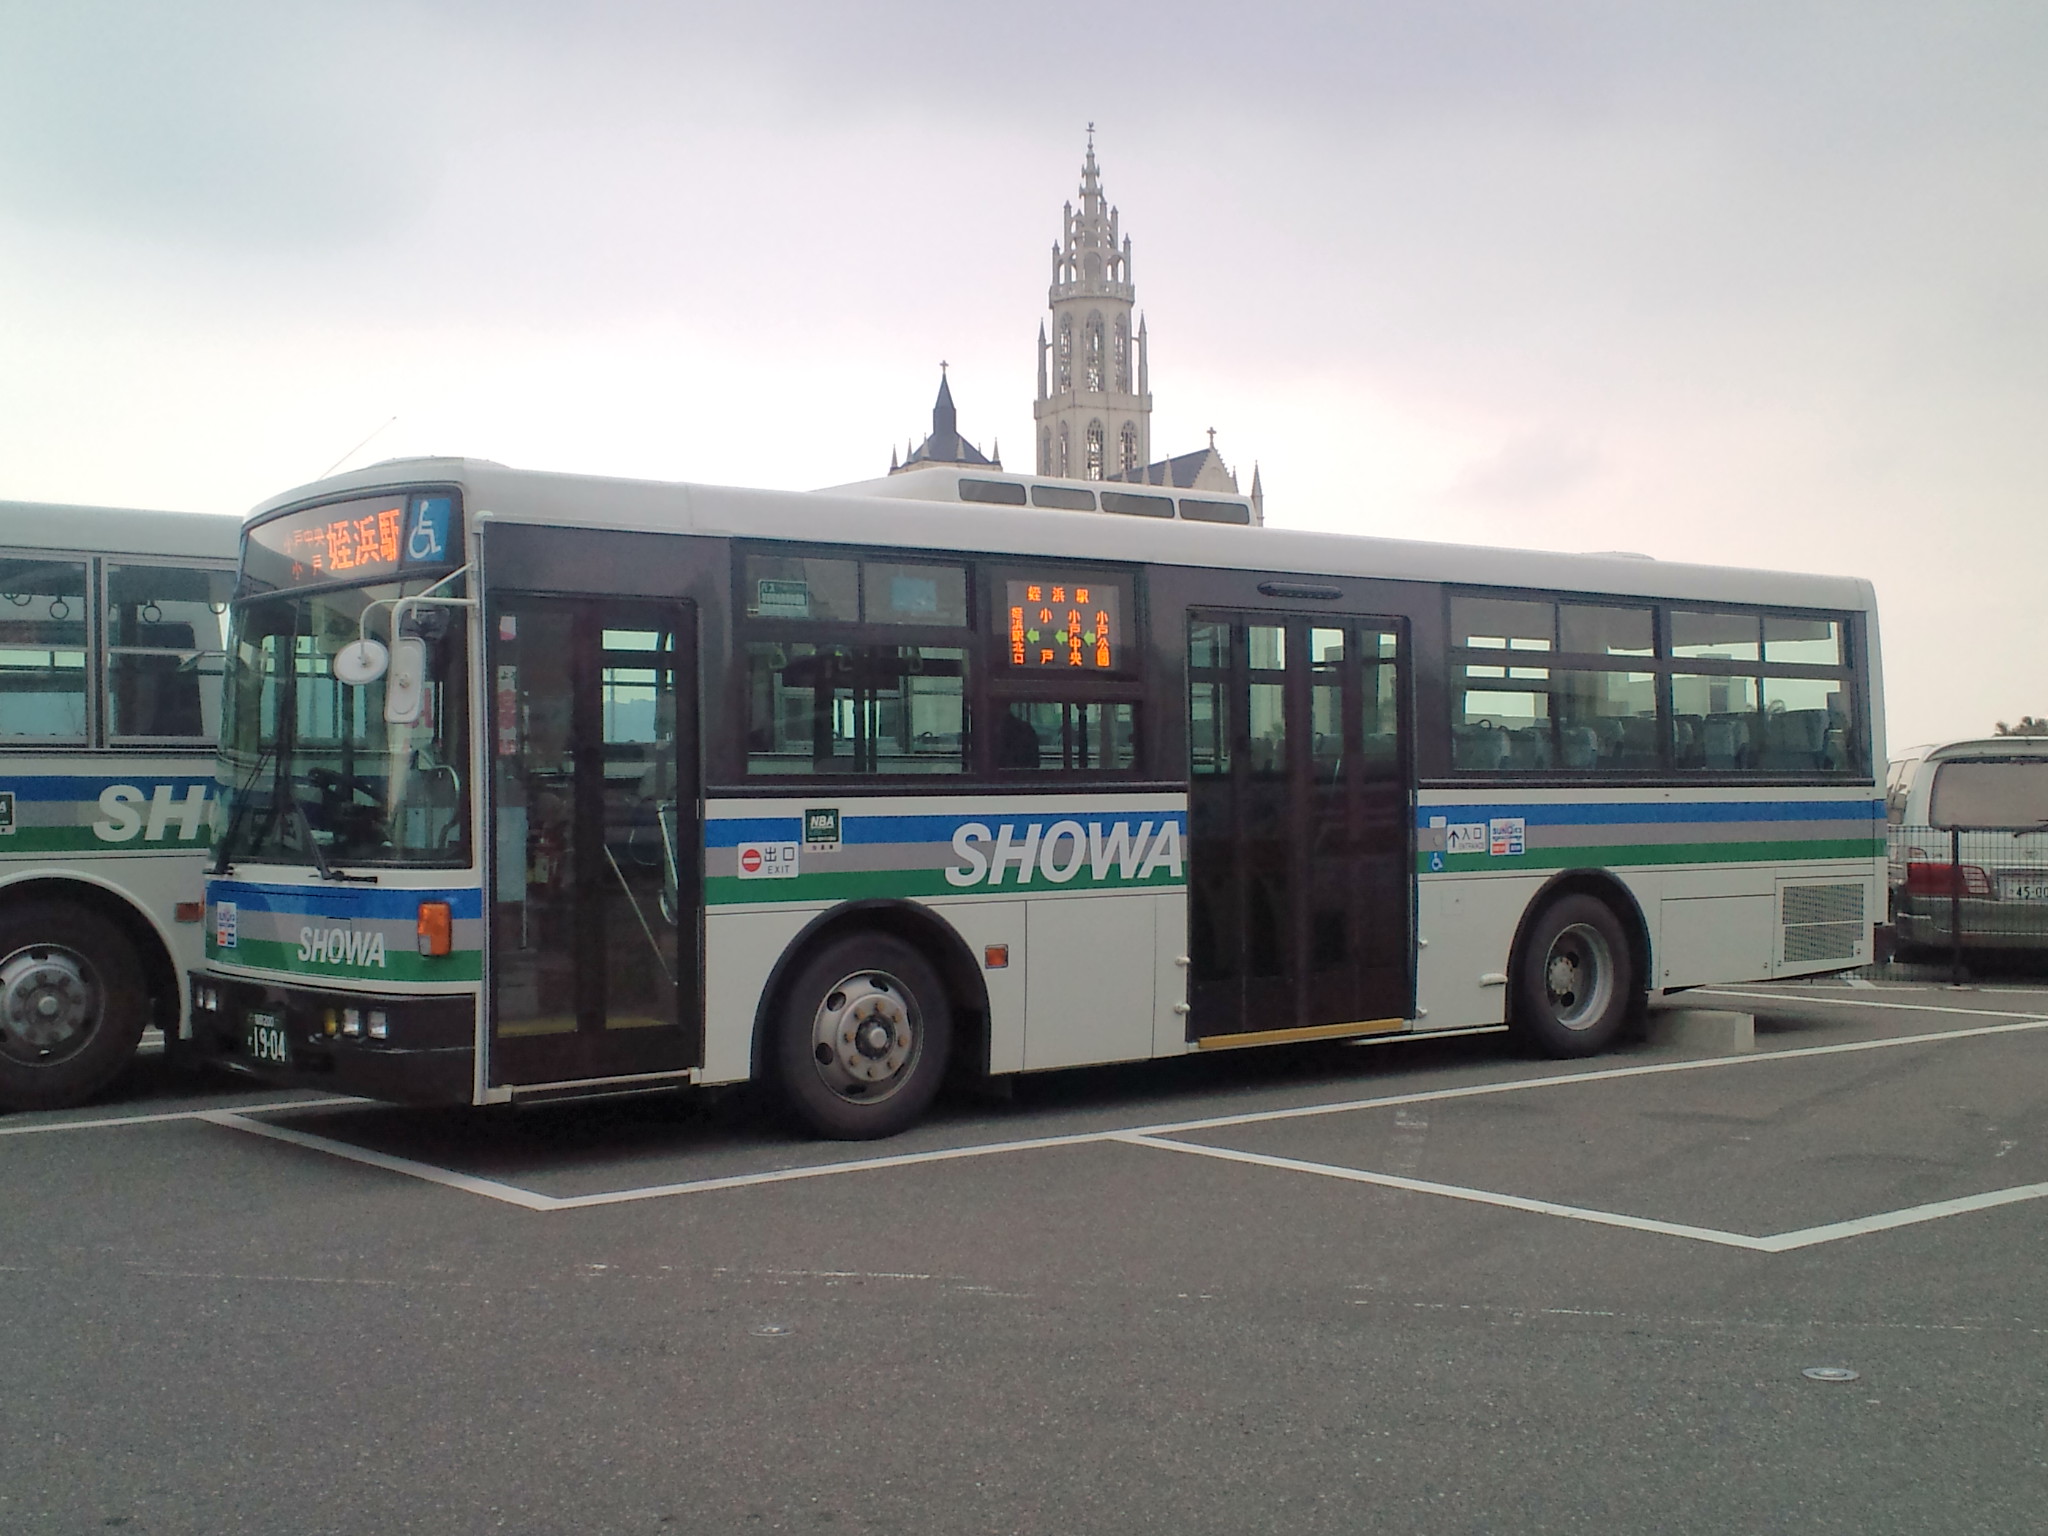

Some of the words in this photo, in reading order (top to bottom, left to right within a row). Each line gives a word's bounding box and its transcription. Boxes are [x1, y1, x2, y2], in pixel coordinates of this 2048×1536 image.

[326, 508, 401, 570] 姪浜駅
[1027, 584, 1090, 604] 姪浜駅
[1010, 606, 1025, 665] 姪浜駅北口
[1068, 608, 1083, 667] 小戸中央
[1095, 610, 1110, 667] 小戸公園
[810, 815, 835, 829] NBA
[1461, 827, 1482, 840] 入口
[764, 846, 795, 862] 出口
[767, 865, 791, 875] EXIT
[943, 819, 1183, 888] SHOWA
[297, 926, 386, 968] SHOWA
[253, 1026, 286, 1063] 19-04
